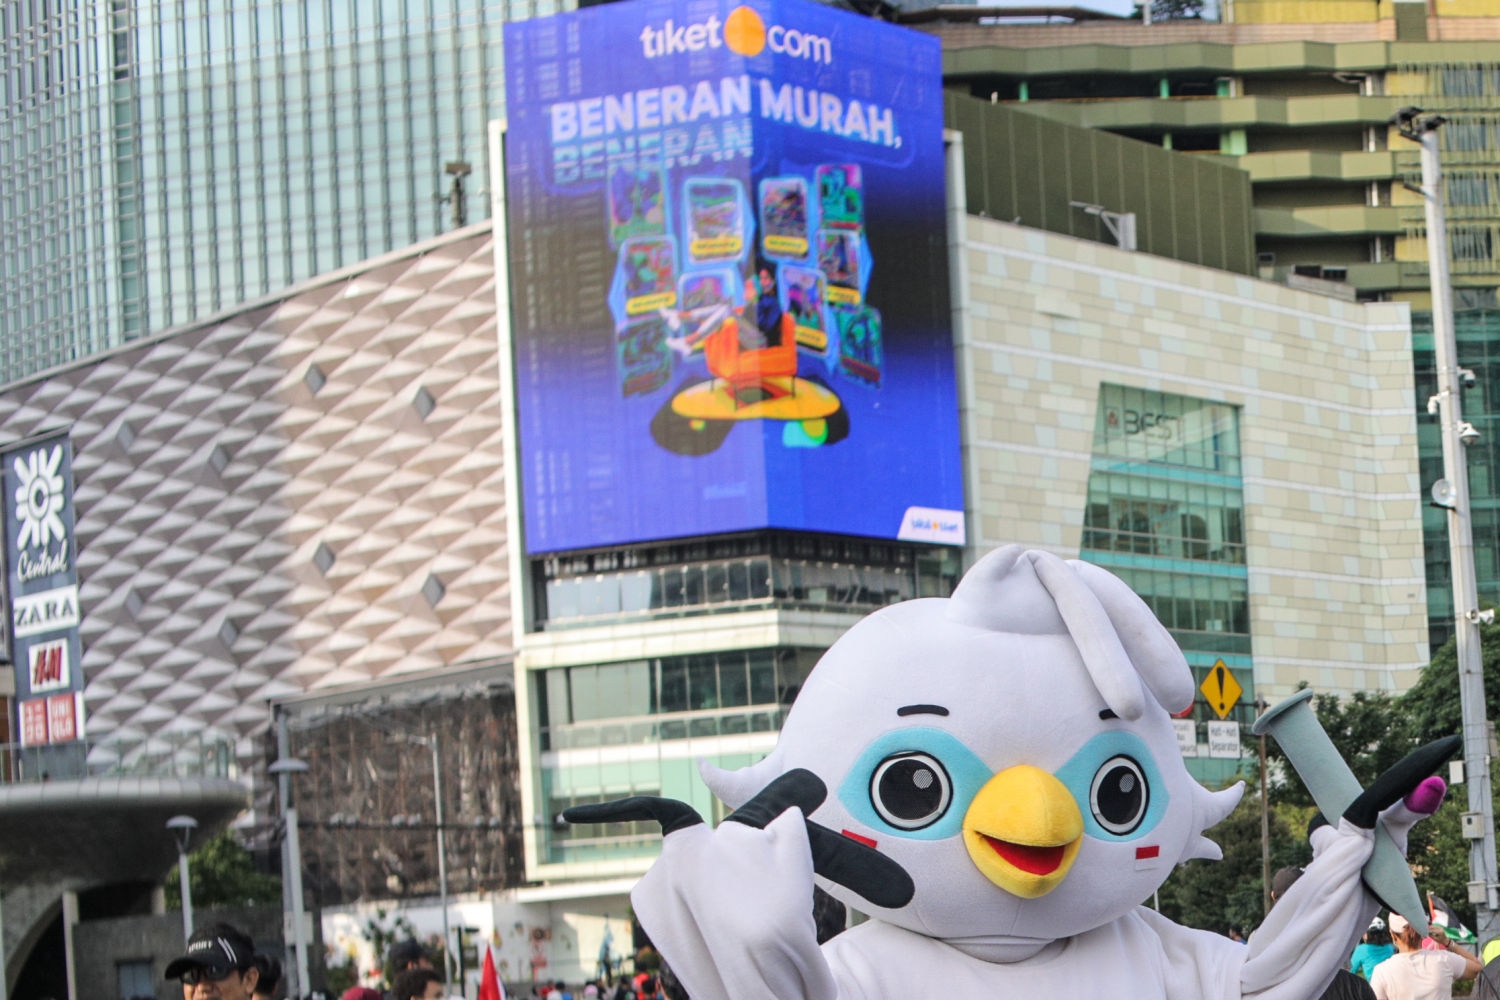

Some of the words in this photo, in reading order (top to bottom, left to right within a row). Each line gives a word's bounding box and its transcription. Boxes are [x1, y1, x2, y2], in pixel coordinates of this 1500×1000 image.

[551, 74, 750, 143] BENERAN
[759, 78, 902, 149] MURAH,
[17, 538, 69, 582] Central
[13, 596, 74, 626] ZARA
